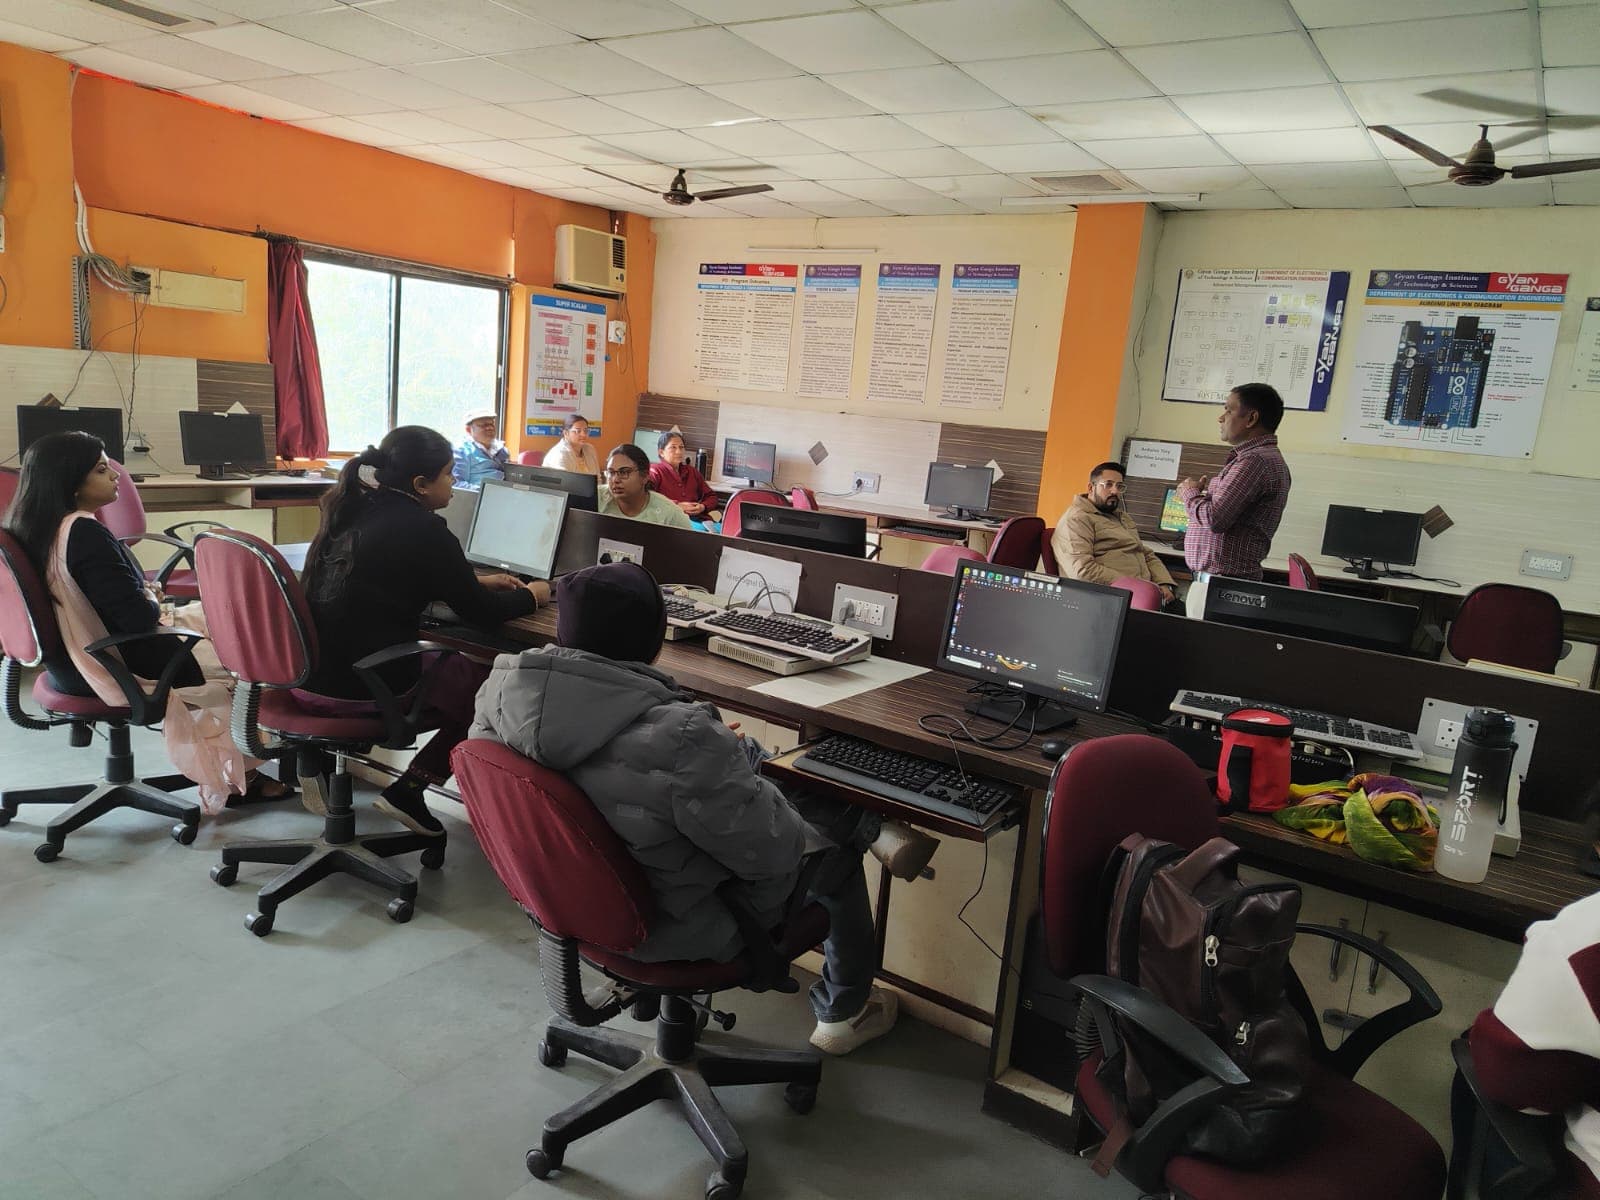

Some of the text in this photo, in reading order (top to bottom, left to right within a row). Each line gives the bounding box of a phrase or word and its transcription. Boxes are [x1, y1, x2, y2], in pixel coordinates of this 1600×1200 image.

[1394, 273, 1415, 283] Gyan
[1445, 274, 1480, 282] Institute
[1464, 293, 1516, 301] COMMUNICATION
[1218, 589, 1262, 606] Lenovo
[1450, 765, 1478, 842] SPORT
